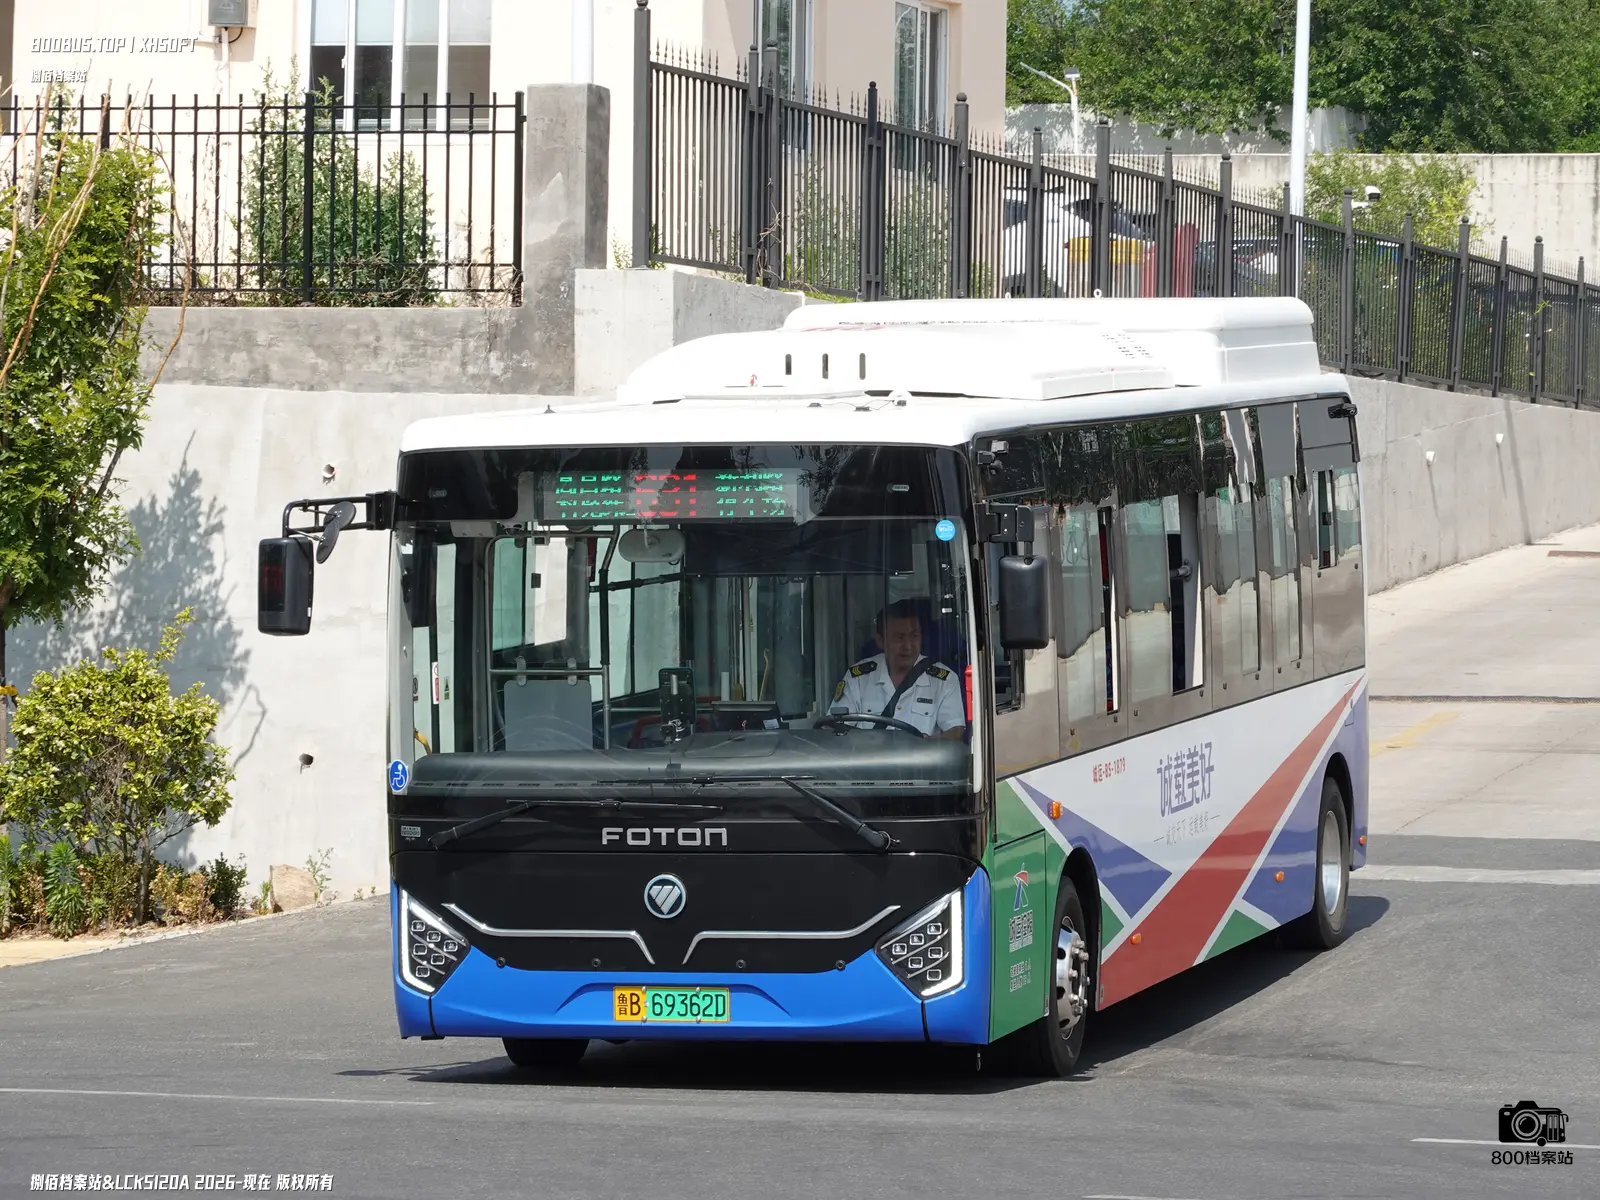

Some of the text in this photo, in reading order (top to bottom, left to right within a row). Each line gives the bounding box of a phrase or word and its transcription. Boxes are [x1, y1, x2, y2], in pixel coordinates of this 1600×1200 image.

[1157, 741, 1215, 818] 诚载美好
[602, 827, 728, 846] FOTON
